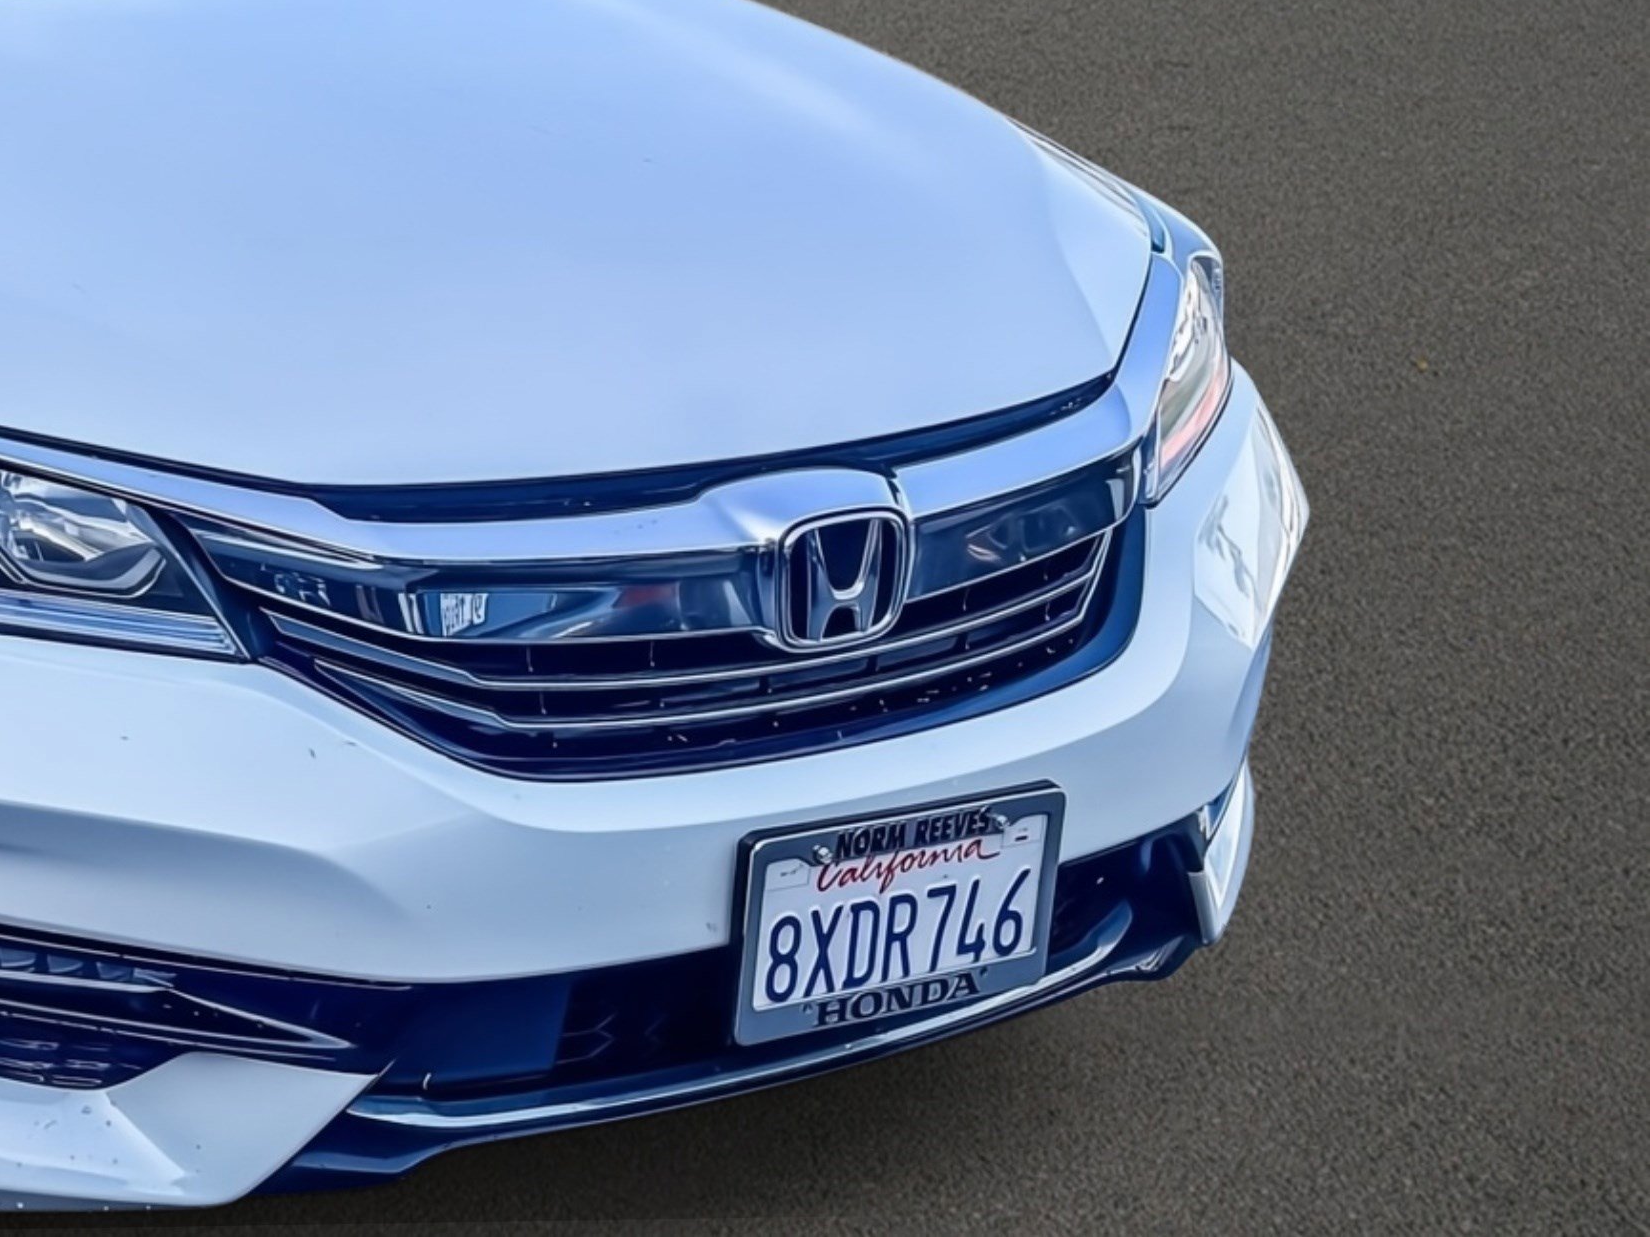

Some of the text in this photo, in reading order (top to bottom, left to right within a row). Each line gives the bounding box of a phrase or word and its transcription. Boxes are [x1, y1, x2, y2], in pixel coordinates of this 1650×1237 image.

[835, 824, 906, 860] NORM
[915, 805, 992, 847] REEVES
[815, 837, 1000, 895] California
[764, 867, 1033, 1004] 8XDR746
[814, 970, 981, 1028] HONDA
